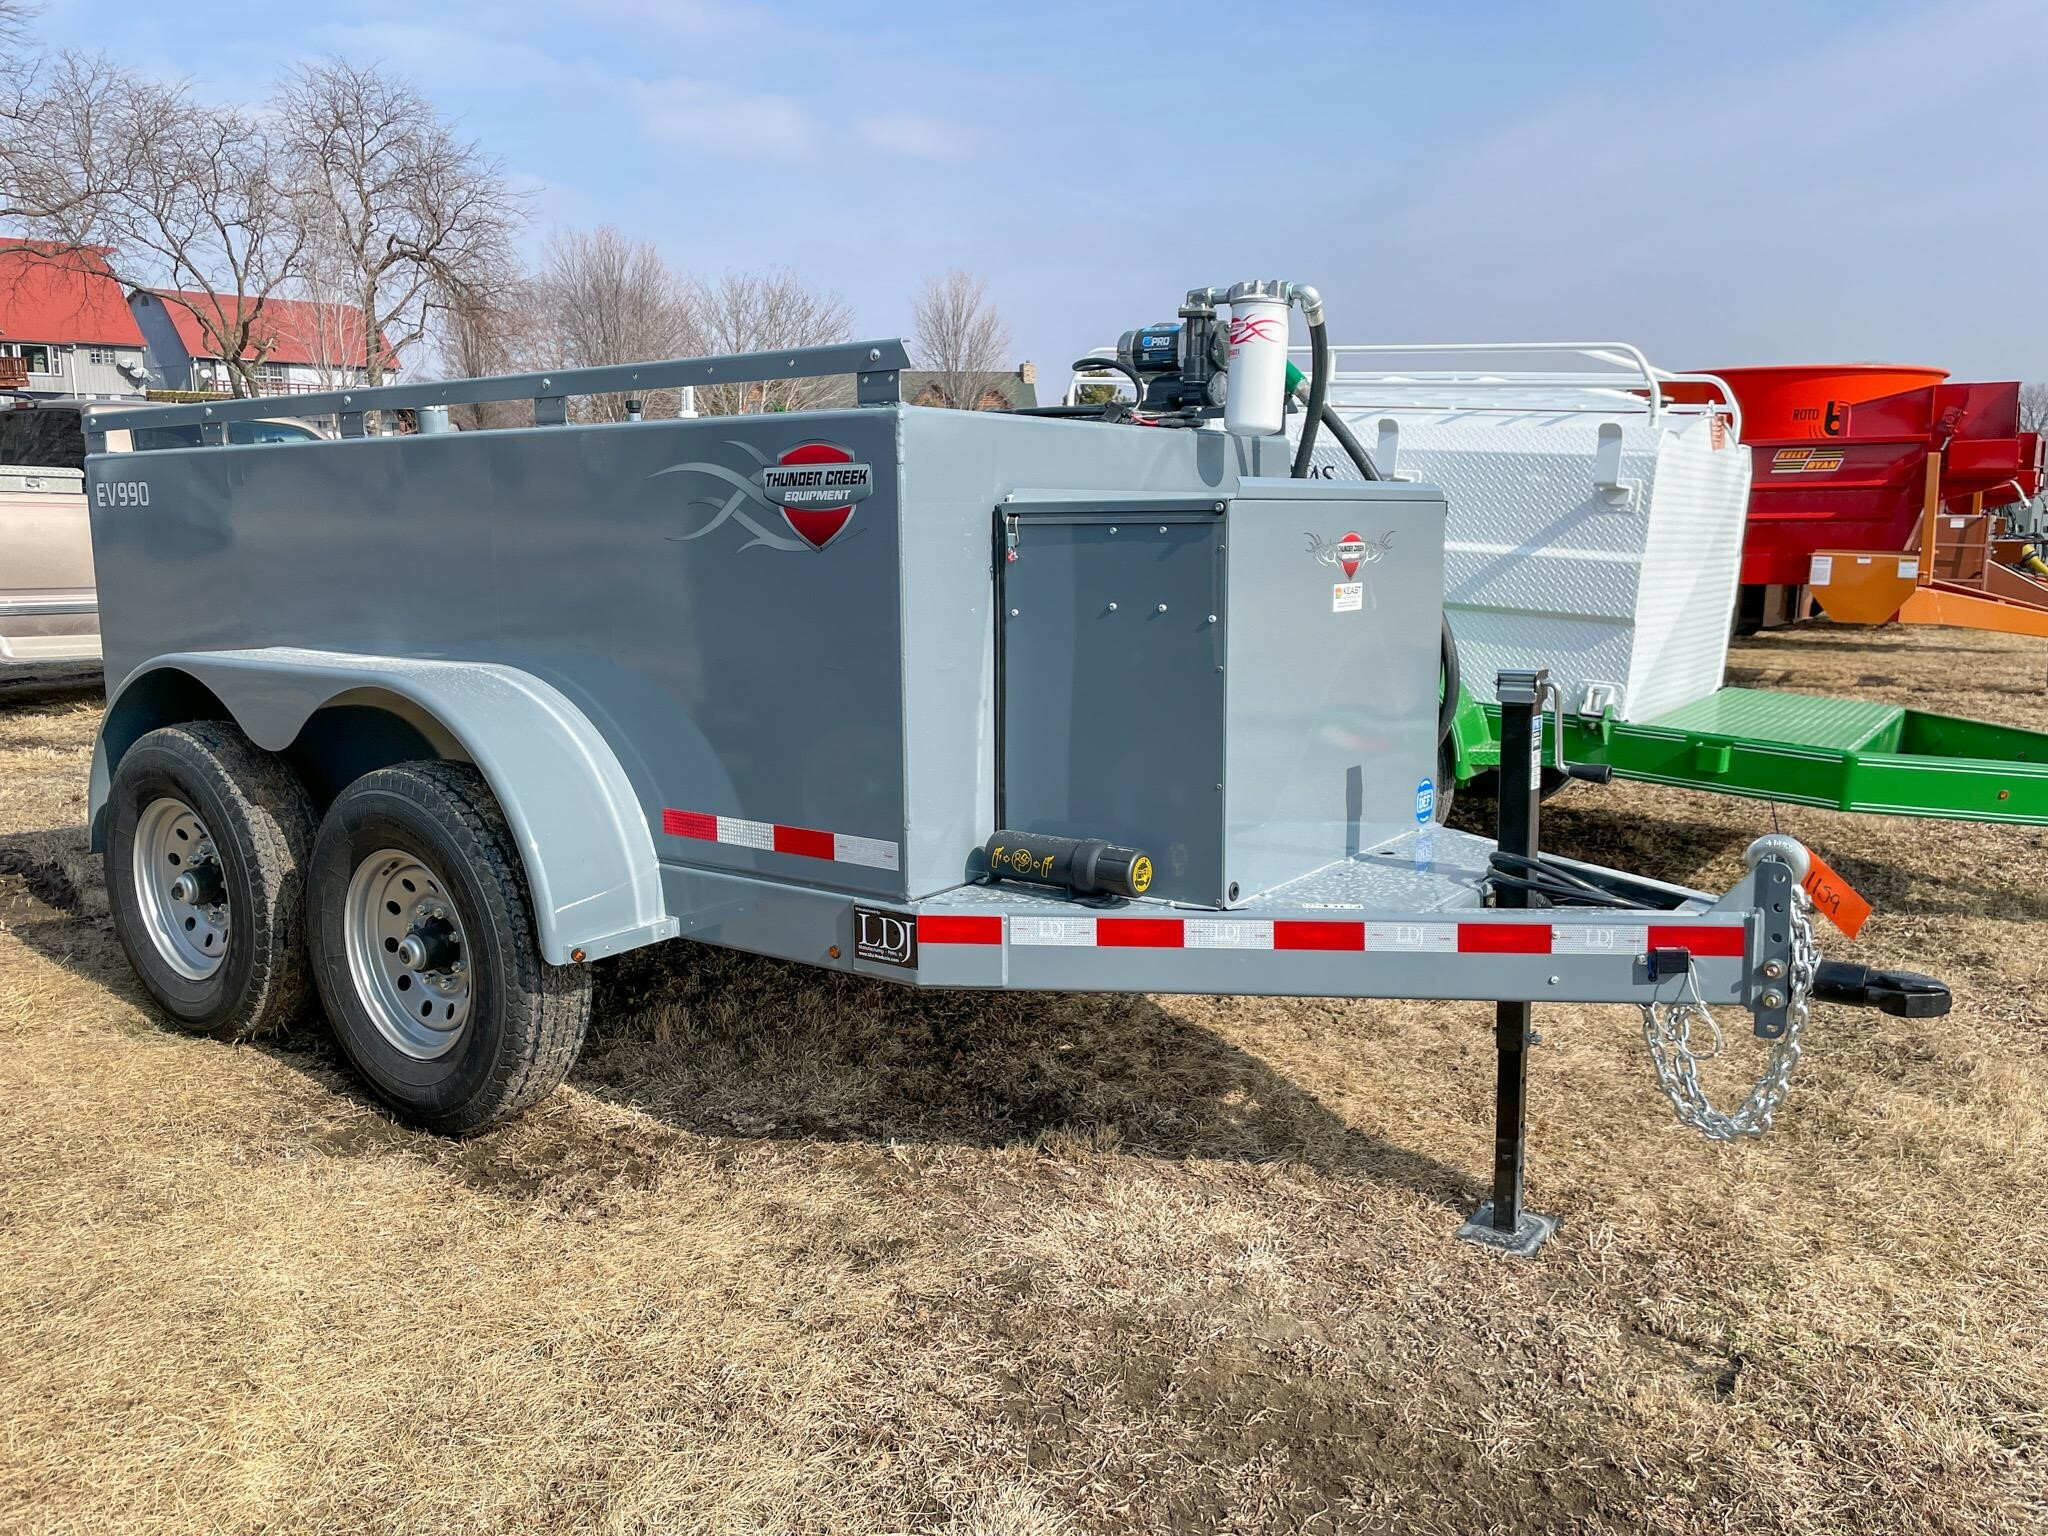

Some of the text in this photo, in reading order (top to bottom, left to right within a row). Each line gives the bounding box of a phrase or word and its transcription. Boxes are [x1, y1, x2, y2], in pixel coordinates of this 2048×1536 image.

[1792, 408, 1819, 421] ROTO
[1778, 450, 1810, 459] KELLY
[1806, 460, 1839, 470] RYAN
[766, 469, 868, 487] THUNDER CREEK
[96, 481, 149, 507] EV990
[784, 490, 851, 502] EQUIPMENT
[858, 913, 916, 963] LDJ
[1039, 920, 1065, 941] LDJ
[1214, 923, 1240, 943] LDJ
[1395, 926, 1424, 947] LDJ
[1585, 929, 1614, 950] LDJ
